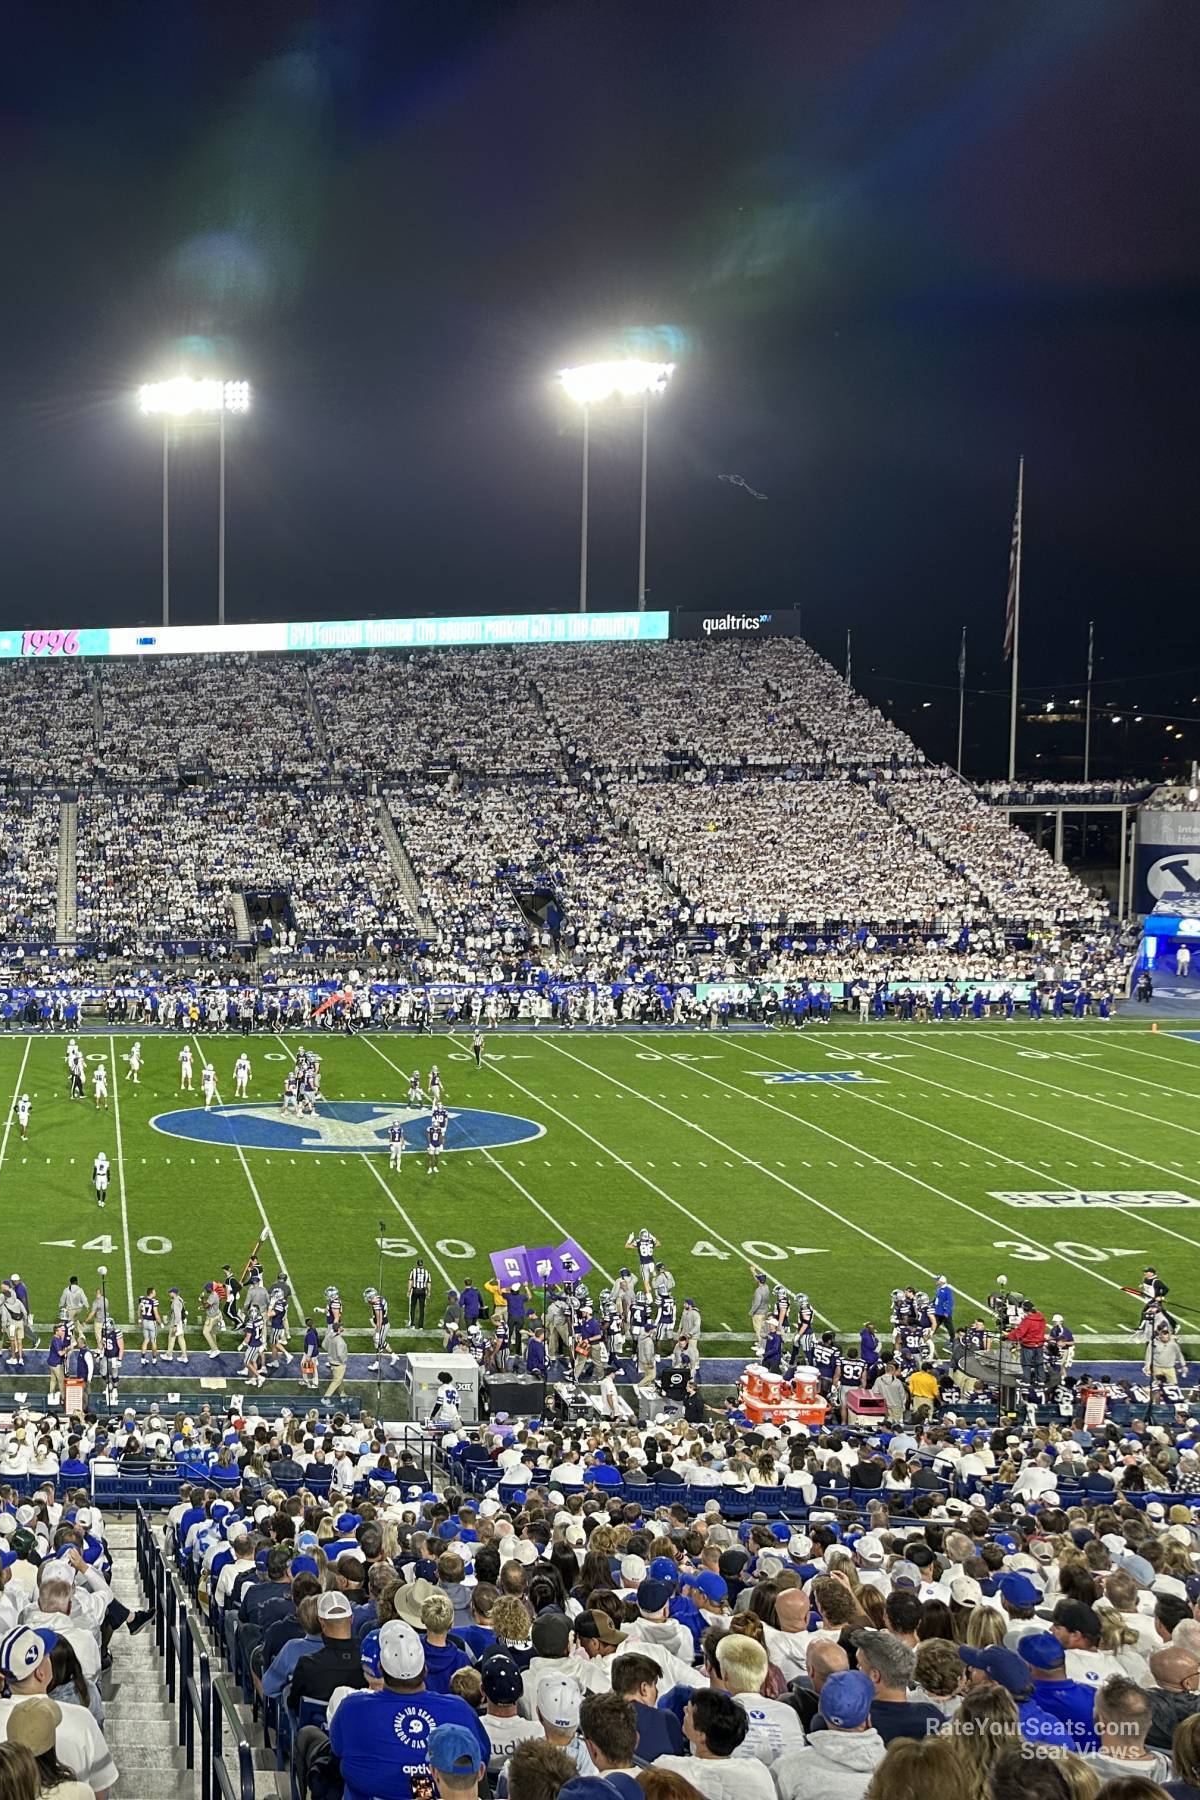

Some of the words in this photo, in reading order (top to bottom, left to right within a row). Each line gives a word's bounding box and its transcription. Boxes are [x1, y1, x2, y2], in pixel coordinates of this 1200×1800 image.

[702, 613, 760, 635] qualtrics
[20, 631, 81, 655] 1996
[1035, 1192, 1188, 1207] PACS
[905, 1336, 920, 1348] 91
[813, 1349, 832, 1365] 55
[842, 1365, 864, 1380] 93
[404, 1706, 417, 1716] 100
[394, 1712, 410, 1745] FOOTBALL
